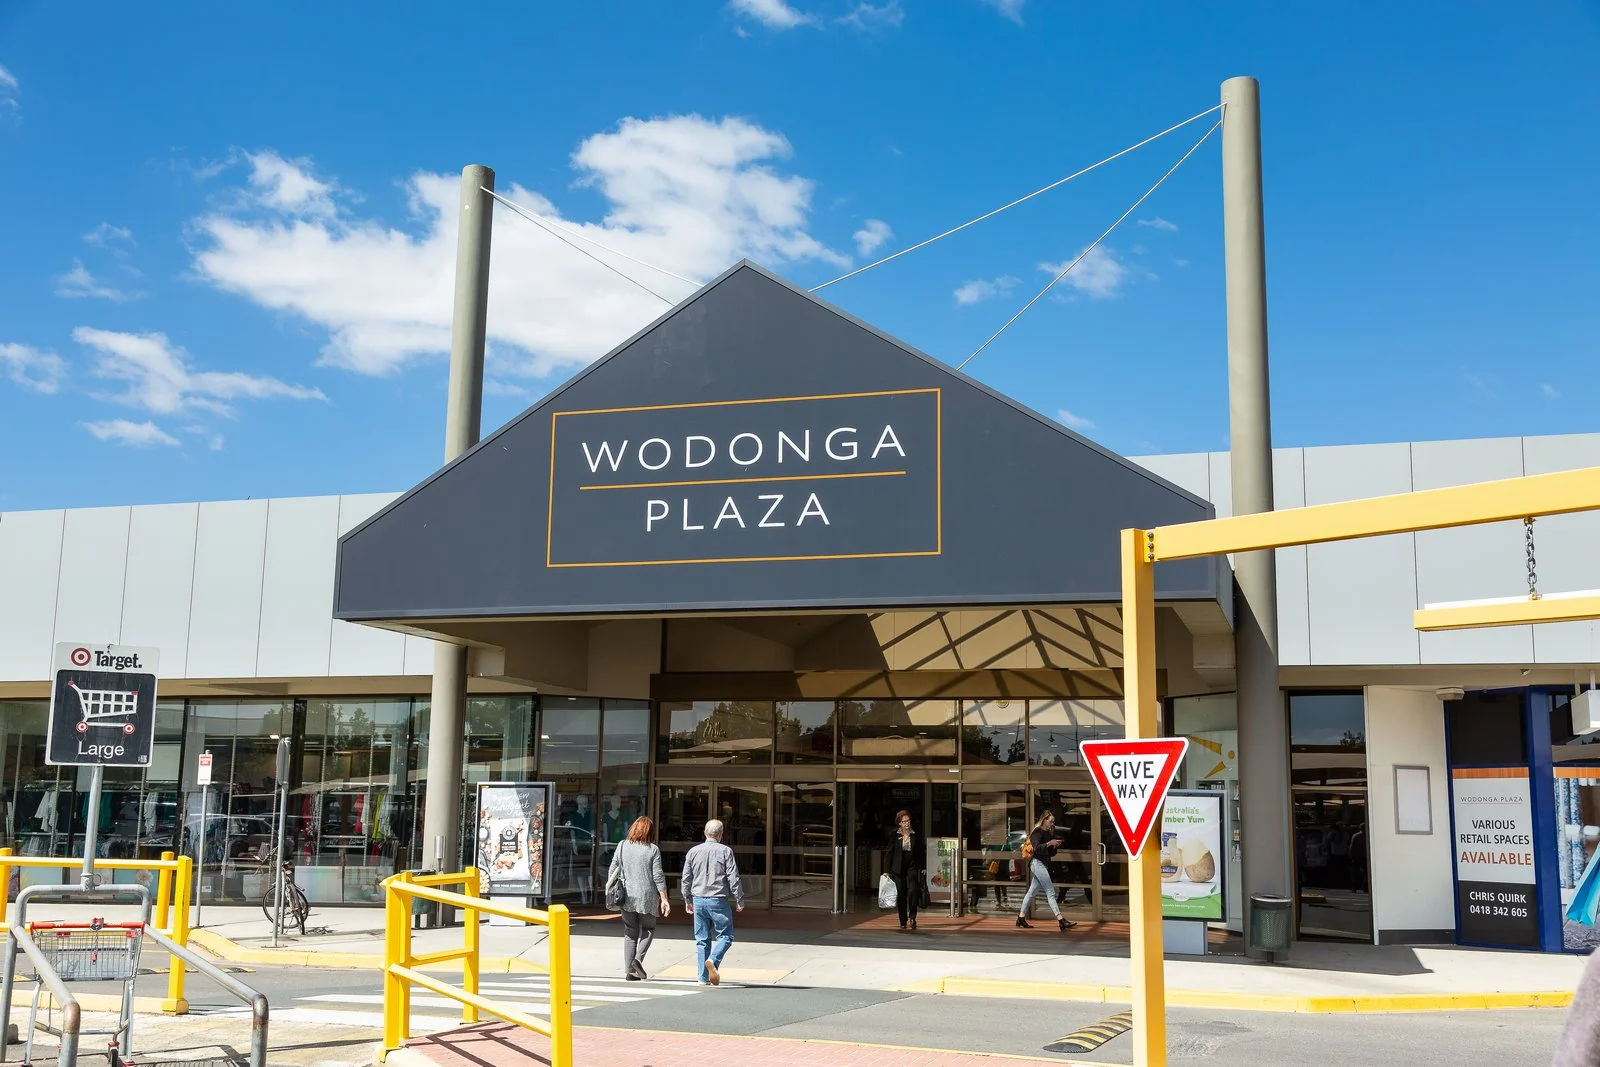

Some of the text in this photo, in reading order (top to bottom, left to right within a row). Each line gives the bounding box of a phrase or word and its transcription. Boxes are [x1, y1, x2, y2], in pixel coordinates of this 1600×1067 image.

[581, 424, 906, 472] WODONGA
[646, 492, 831, 532] PLAZA
[78, 740, 125, 758] Large
[1110, 760, 1155, 780] GIVE
[1117, 783, 1148, 799] WAY
[1164, 815, 1205, 824] mber Yum
[1471, 819, 1516, 830] VARIOUS
[1460, 833, 1530, 845] RETAIL SPACES
[1460, 851, 1532, 866] AVAILABLE
[1469, 891, 1527, 904] CHRIS QUIRK
[1469, 904, 1528, 918] 0418 342 605
